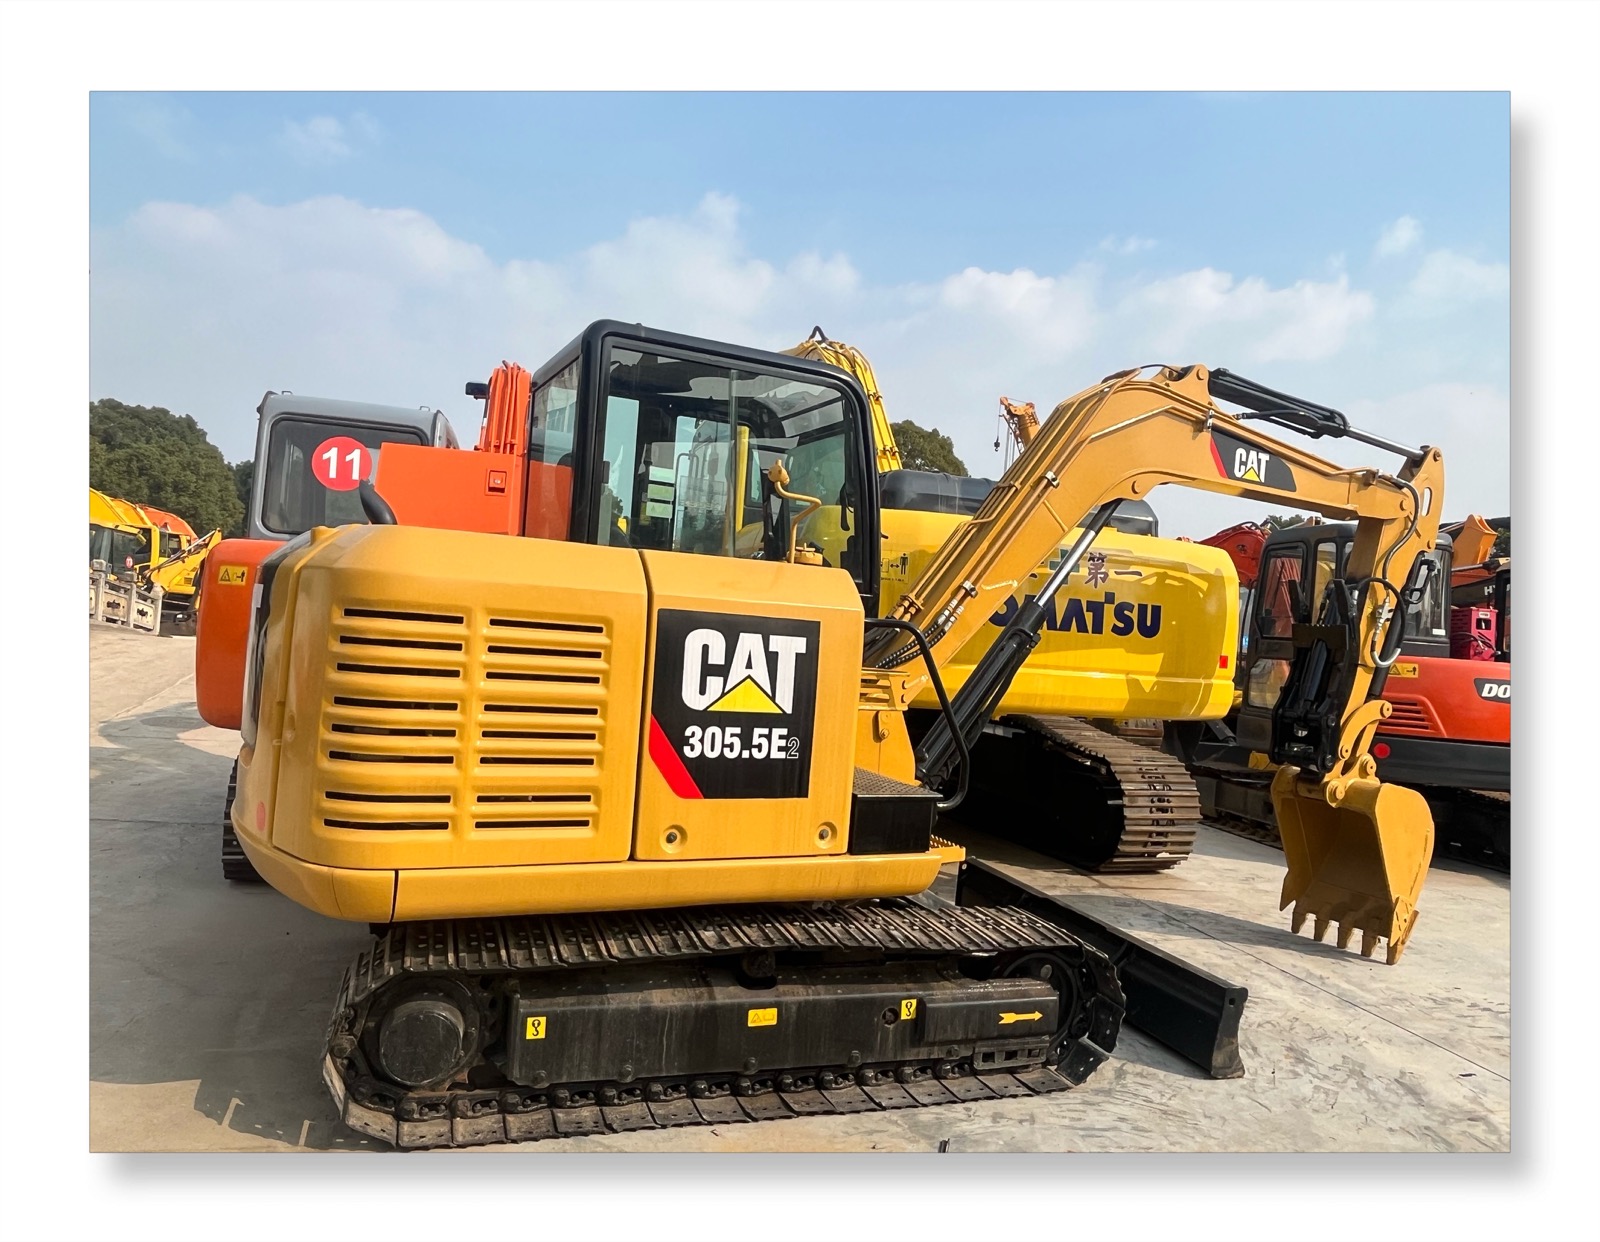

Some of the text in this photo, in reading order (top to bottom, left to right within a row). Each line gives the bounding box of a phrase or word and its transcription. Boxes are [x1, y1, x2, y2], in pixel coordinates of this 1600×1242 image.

[322, 446, 361, 481] 11
[1234, 447, 1270, 483] CAT
[681, 628, 807, 715] CAT
[683, 725, 800, 760] 305.5E2
